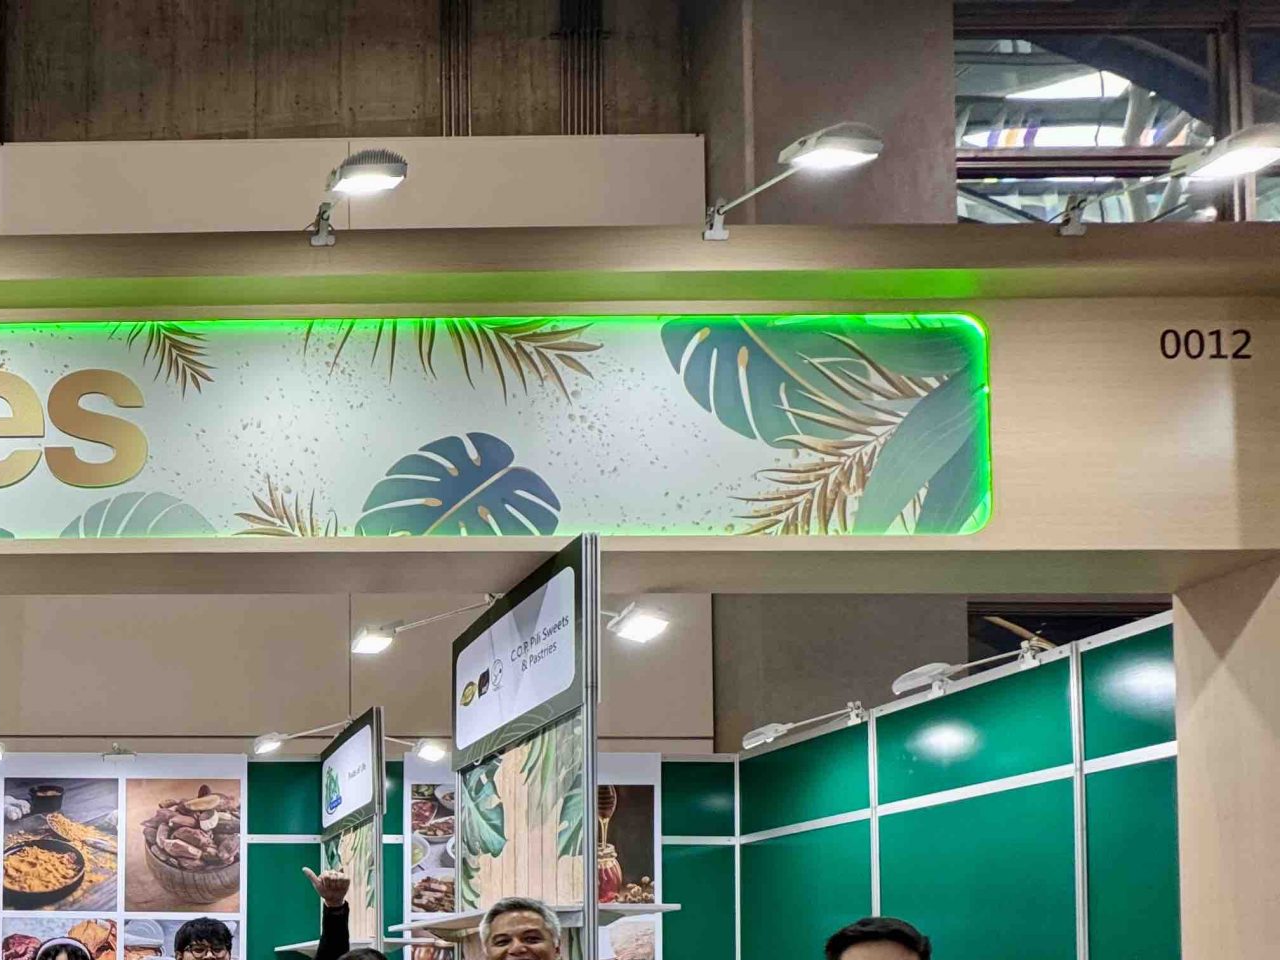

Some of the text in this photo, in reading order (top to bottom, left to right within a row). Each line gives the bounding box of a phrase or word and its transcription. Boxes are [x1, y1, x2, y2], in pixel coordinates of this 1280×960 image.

[1160, 328, 1252, 359] 0012
[530, 632, 541, 649] Pili
[542, 615, 569, 641] Sweets
[521, 641, 557, 672] & Pastries
